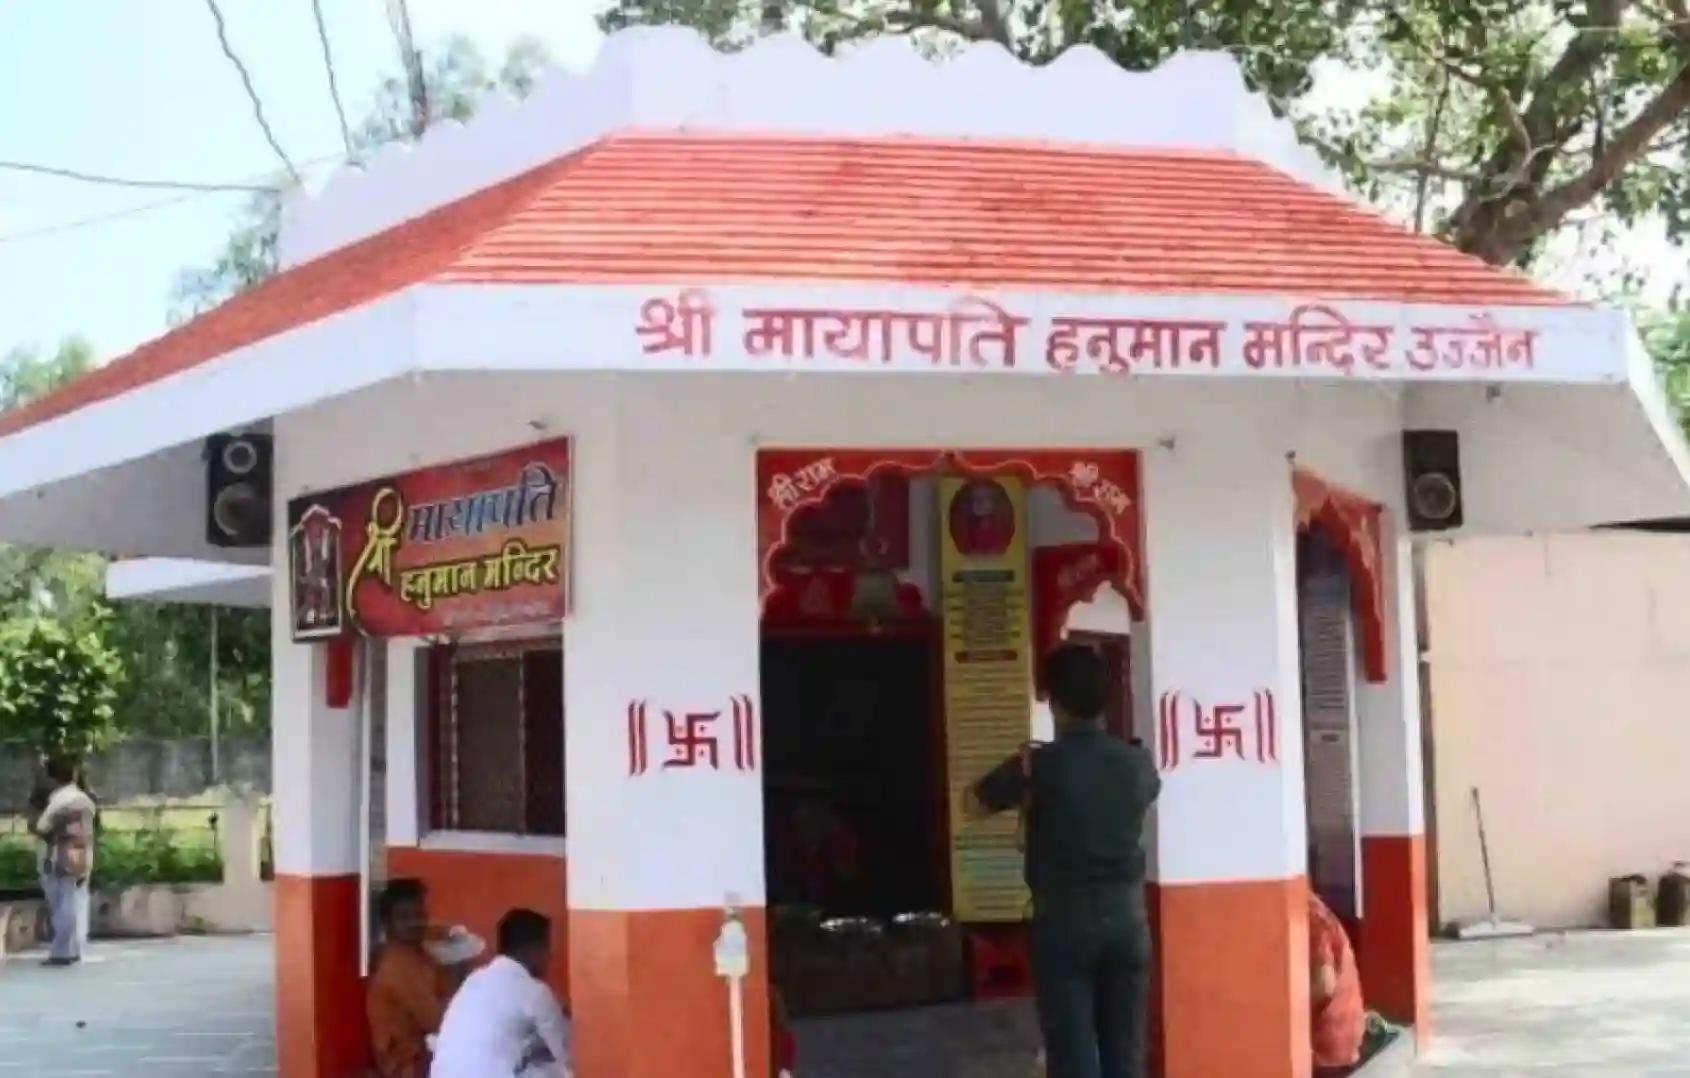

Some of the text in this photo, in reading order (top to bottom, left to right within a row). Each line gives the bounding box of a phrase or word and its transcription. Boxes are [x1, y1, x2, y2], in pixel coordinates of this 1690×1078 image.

[636, 287, 1538, 376] श्री मायापति हनुमान मन्दिर उज्जैन
[345, 461, 556, 638] श्री मायापति
[400, 537, 559, 611] हनुमान मन्दिर
